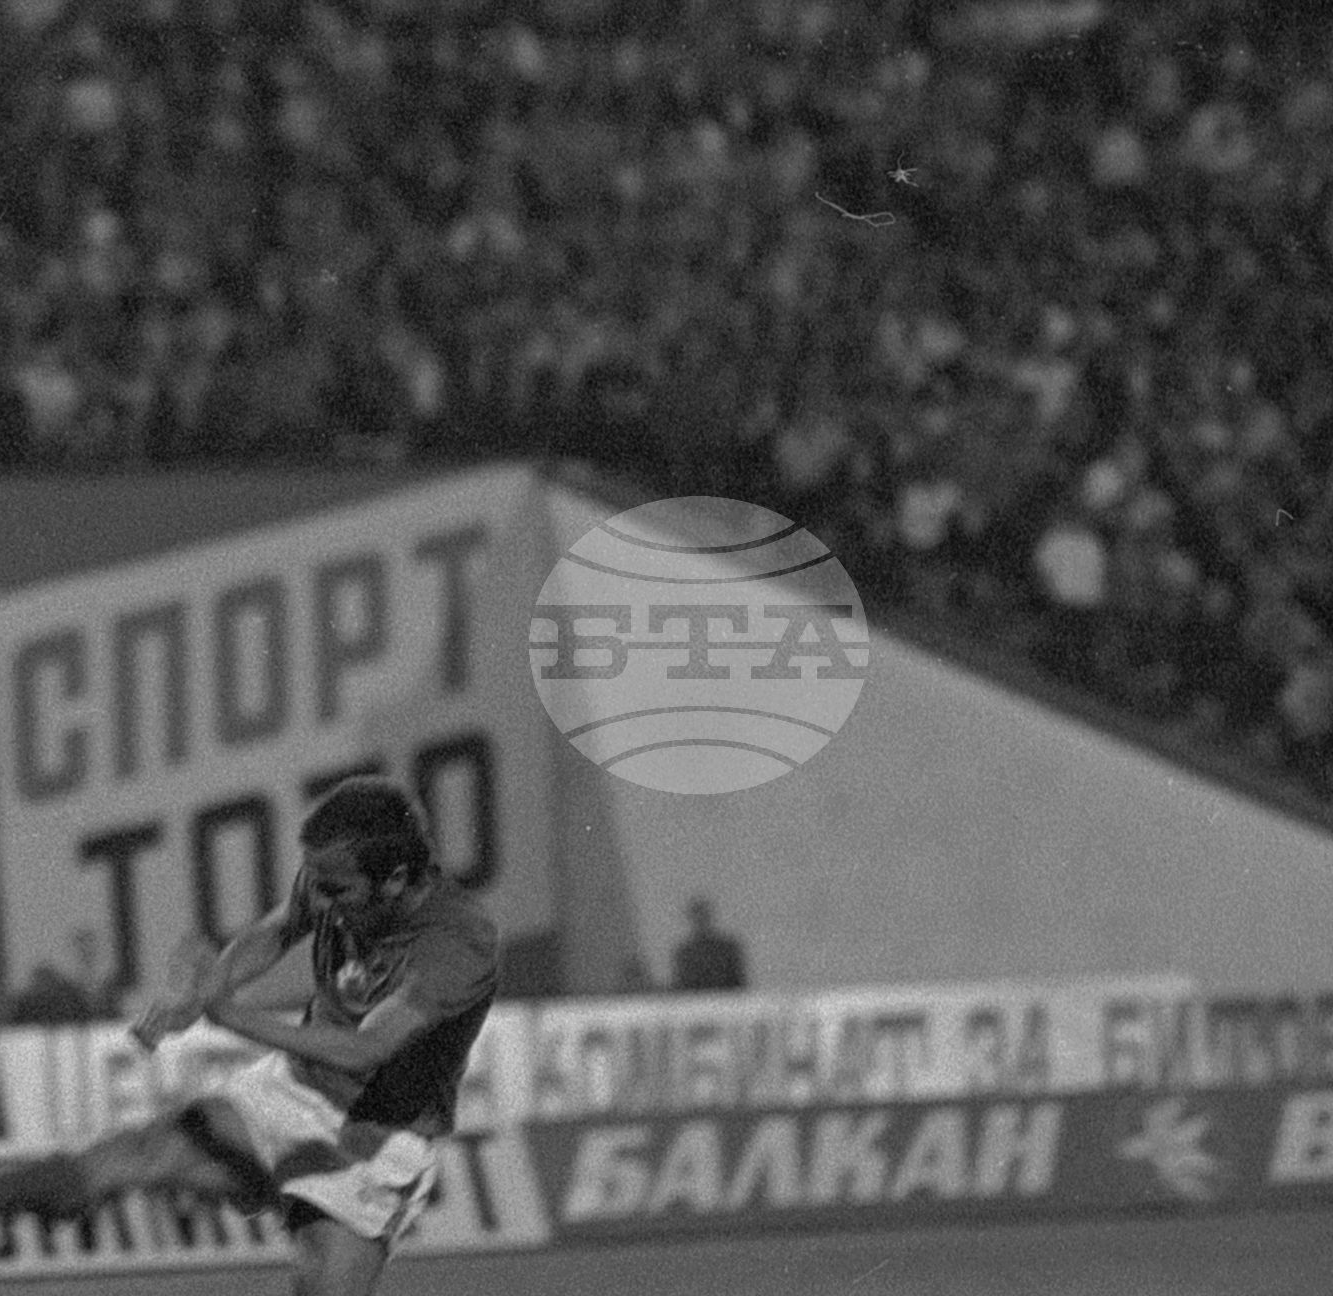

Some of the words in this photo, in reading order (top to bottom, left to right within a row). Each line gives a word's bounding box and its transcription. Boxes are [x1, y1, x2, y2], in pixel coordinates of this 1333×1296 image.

[13, 519, 489, 801] СПОРТ
[76, 732, 496, 996] ТОО
[562, 1104, 1063, 1222] БАЛКАН
